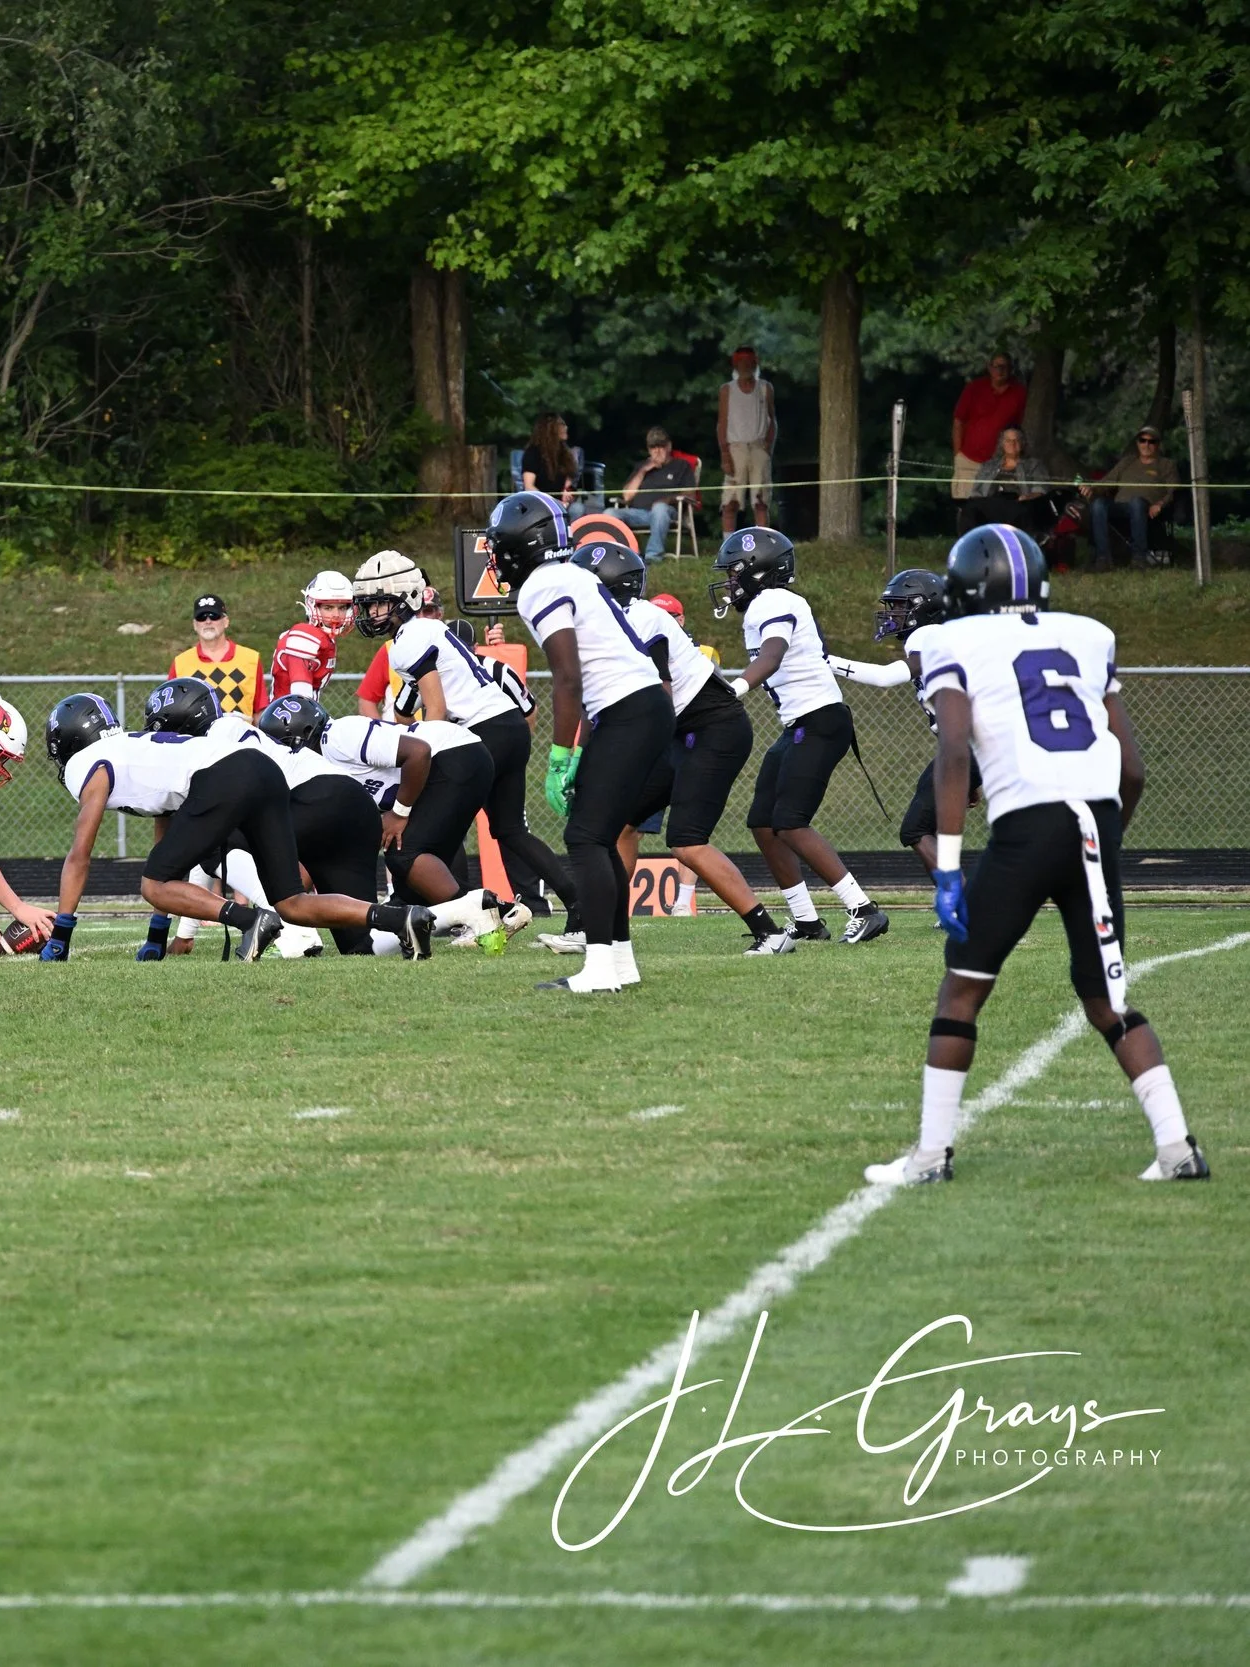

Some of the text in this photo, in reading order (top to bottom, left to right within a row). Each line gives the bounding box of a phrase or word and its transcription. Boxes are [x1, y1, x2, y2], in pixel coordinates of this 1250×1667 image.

[741, 533, 756, 552] 8
[591, 546, 607, 566] 9
[150, 686, 175, 714] 52
[272, 699, 302, 725] 56
[1012, 647, 1097, 753] 6
[631, 866, 681, 916] 20
[1107, 962, 1123, 980] G
